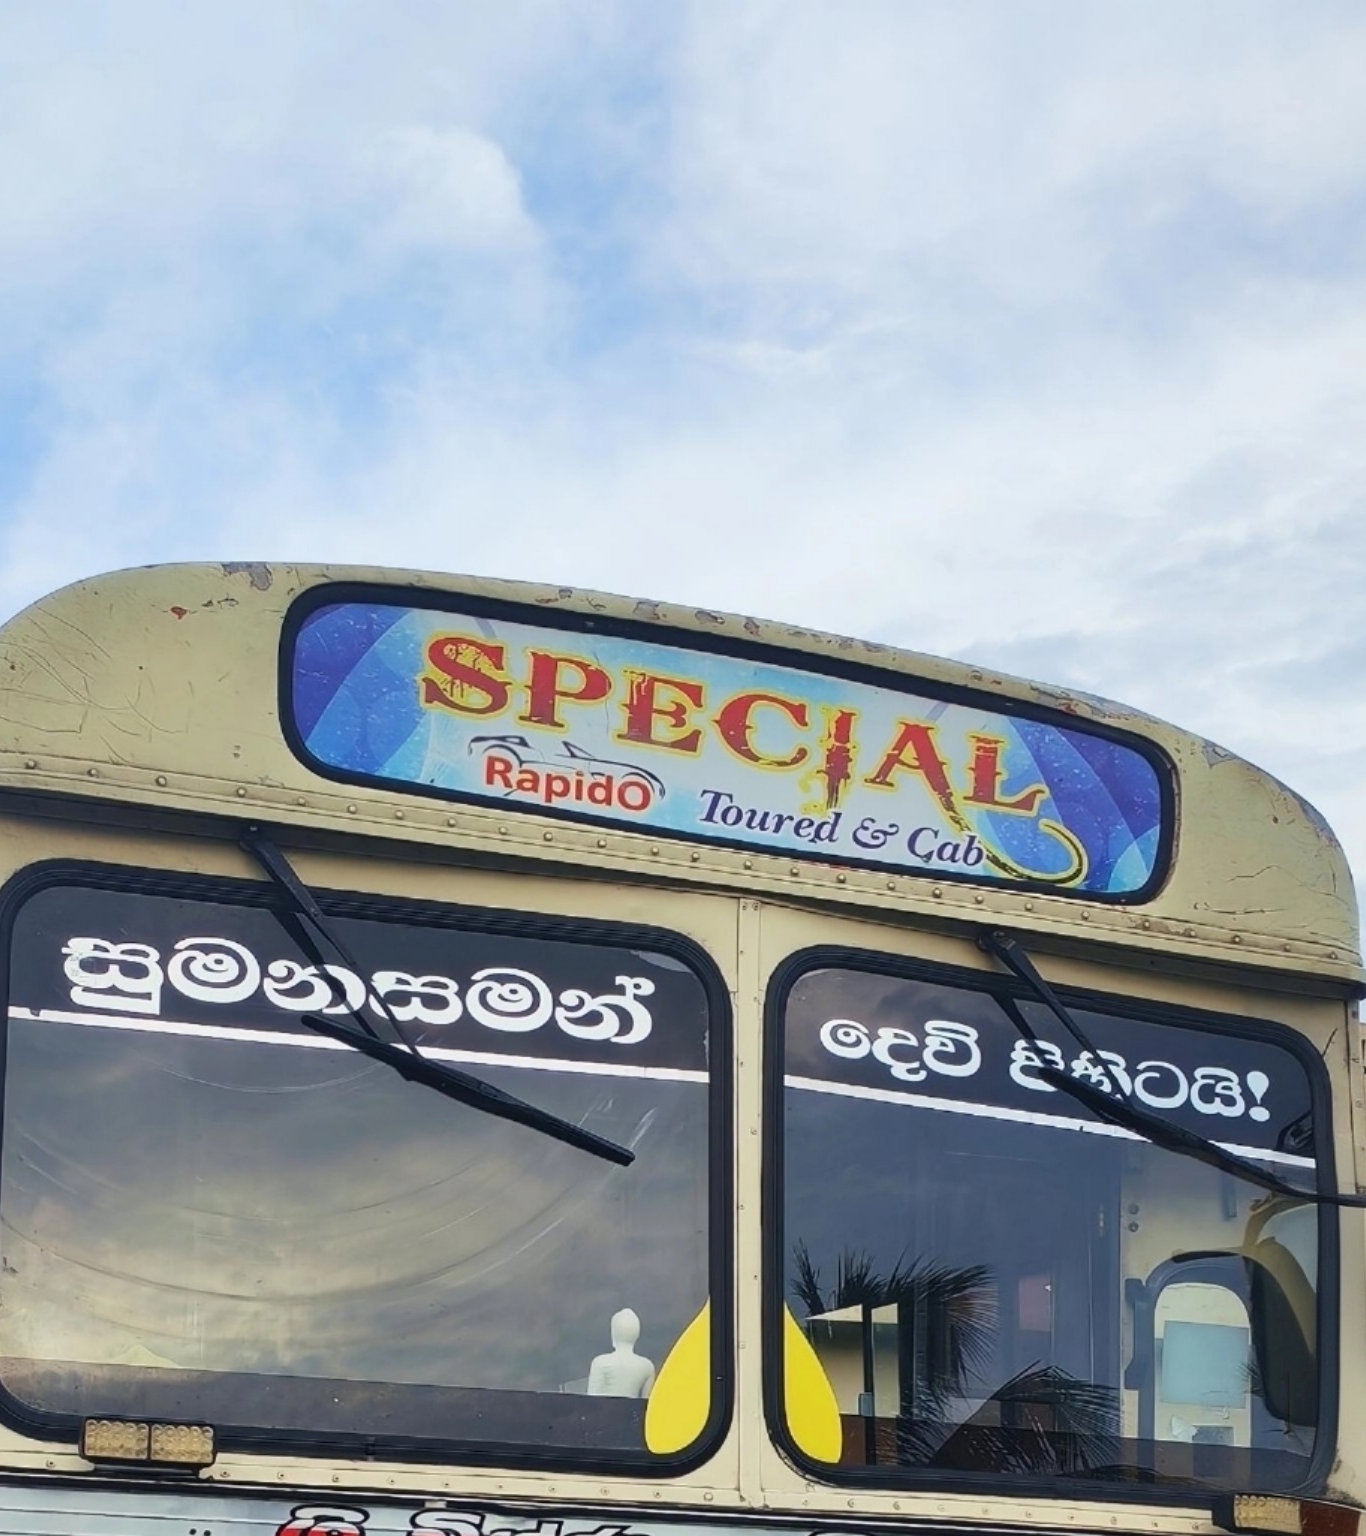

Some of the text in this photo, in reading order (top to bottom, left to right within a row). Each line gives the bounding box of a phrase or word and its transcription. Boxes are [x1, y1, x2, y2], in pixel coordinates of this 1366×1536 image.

[421, 637, 1088, 884] SPECIAL
[701, 789, 985, 868] Toured & Cab
